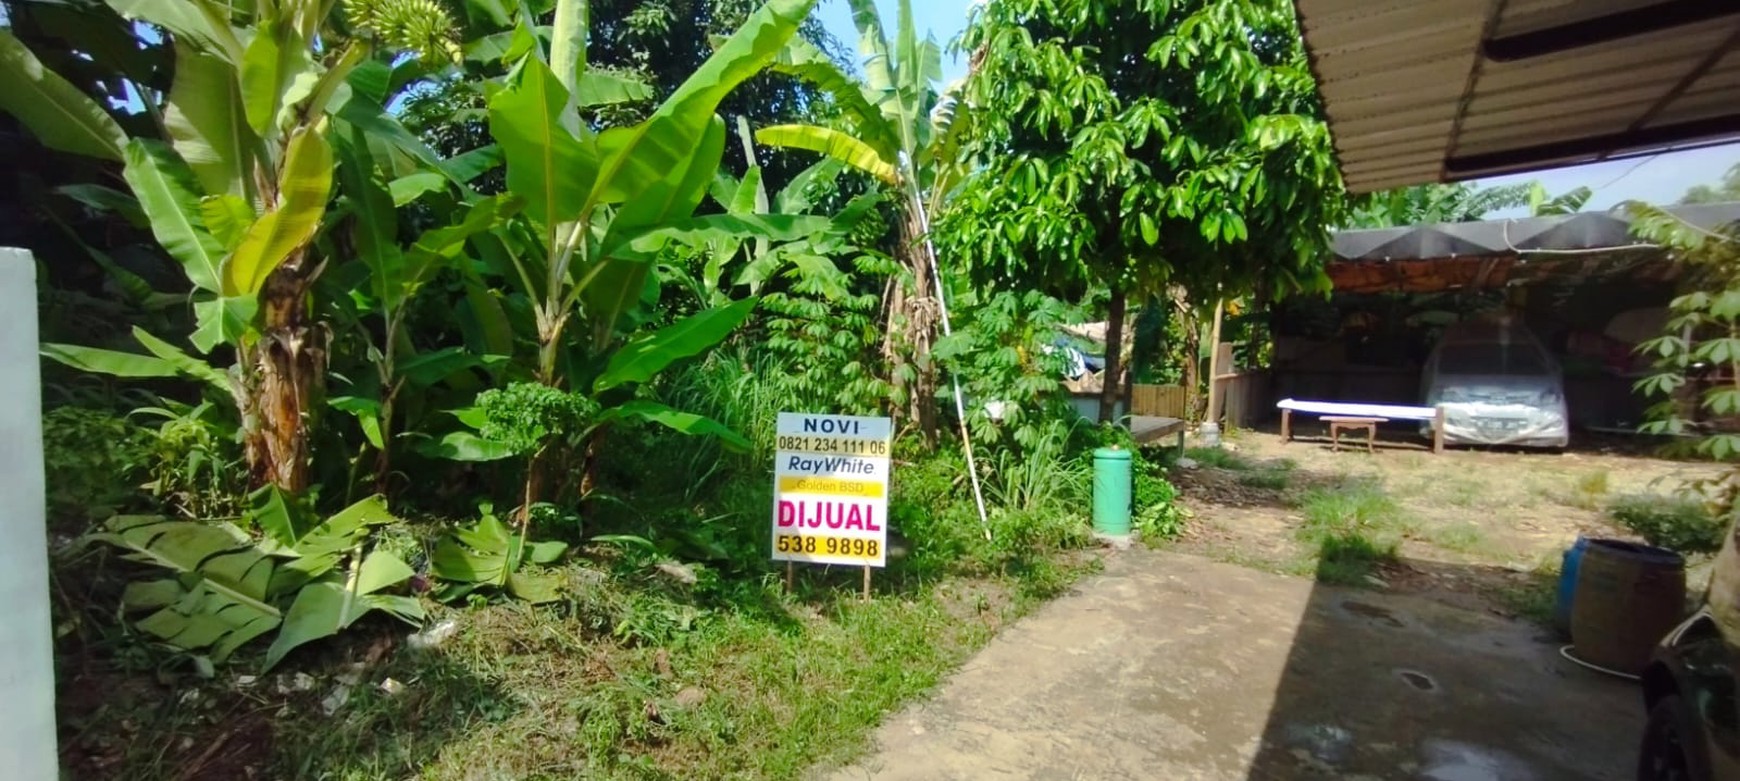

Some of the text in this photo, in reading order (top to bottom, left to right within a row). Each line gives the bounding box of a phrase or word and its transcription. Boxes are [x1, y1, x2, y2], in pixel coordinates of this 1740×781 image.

[804, 418, 859, 435] NOVI
[779, 436, 886, 455] 0821 234 111 06
[796, 479, 864, 493] Golden BSD
[778, 500, 881, 531] DIJUAL
[778, 535, 878, 557] 538 9898
